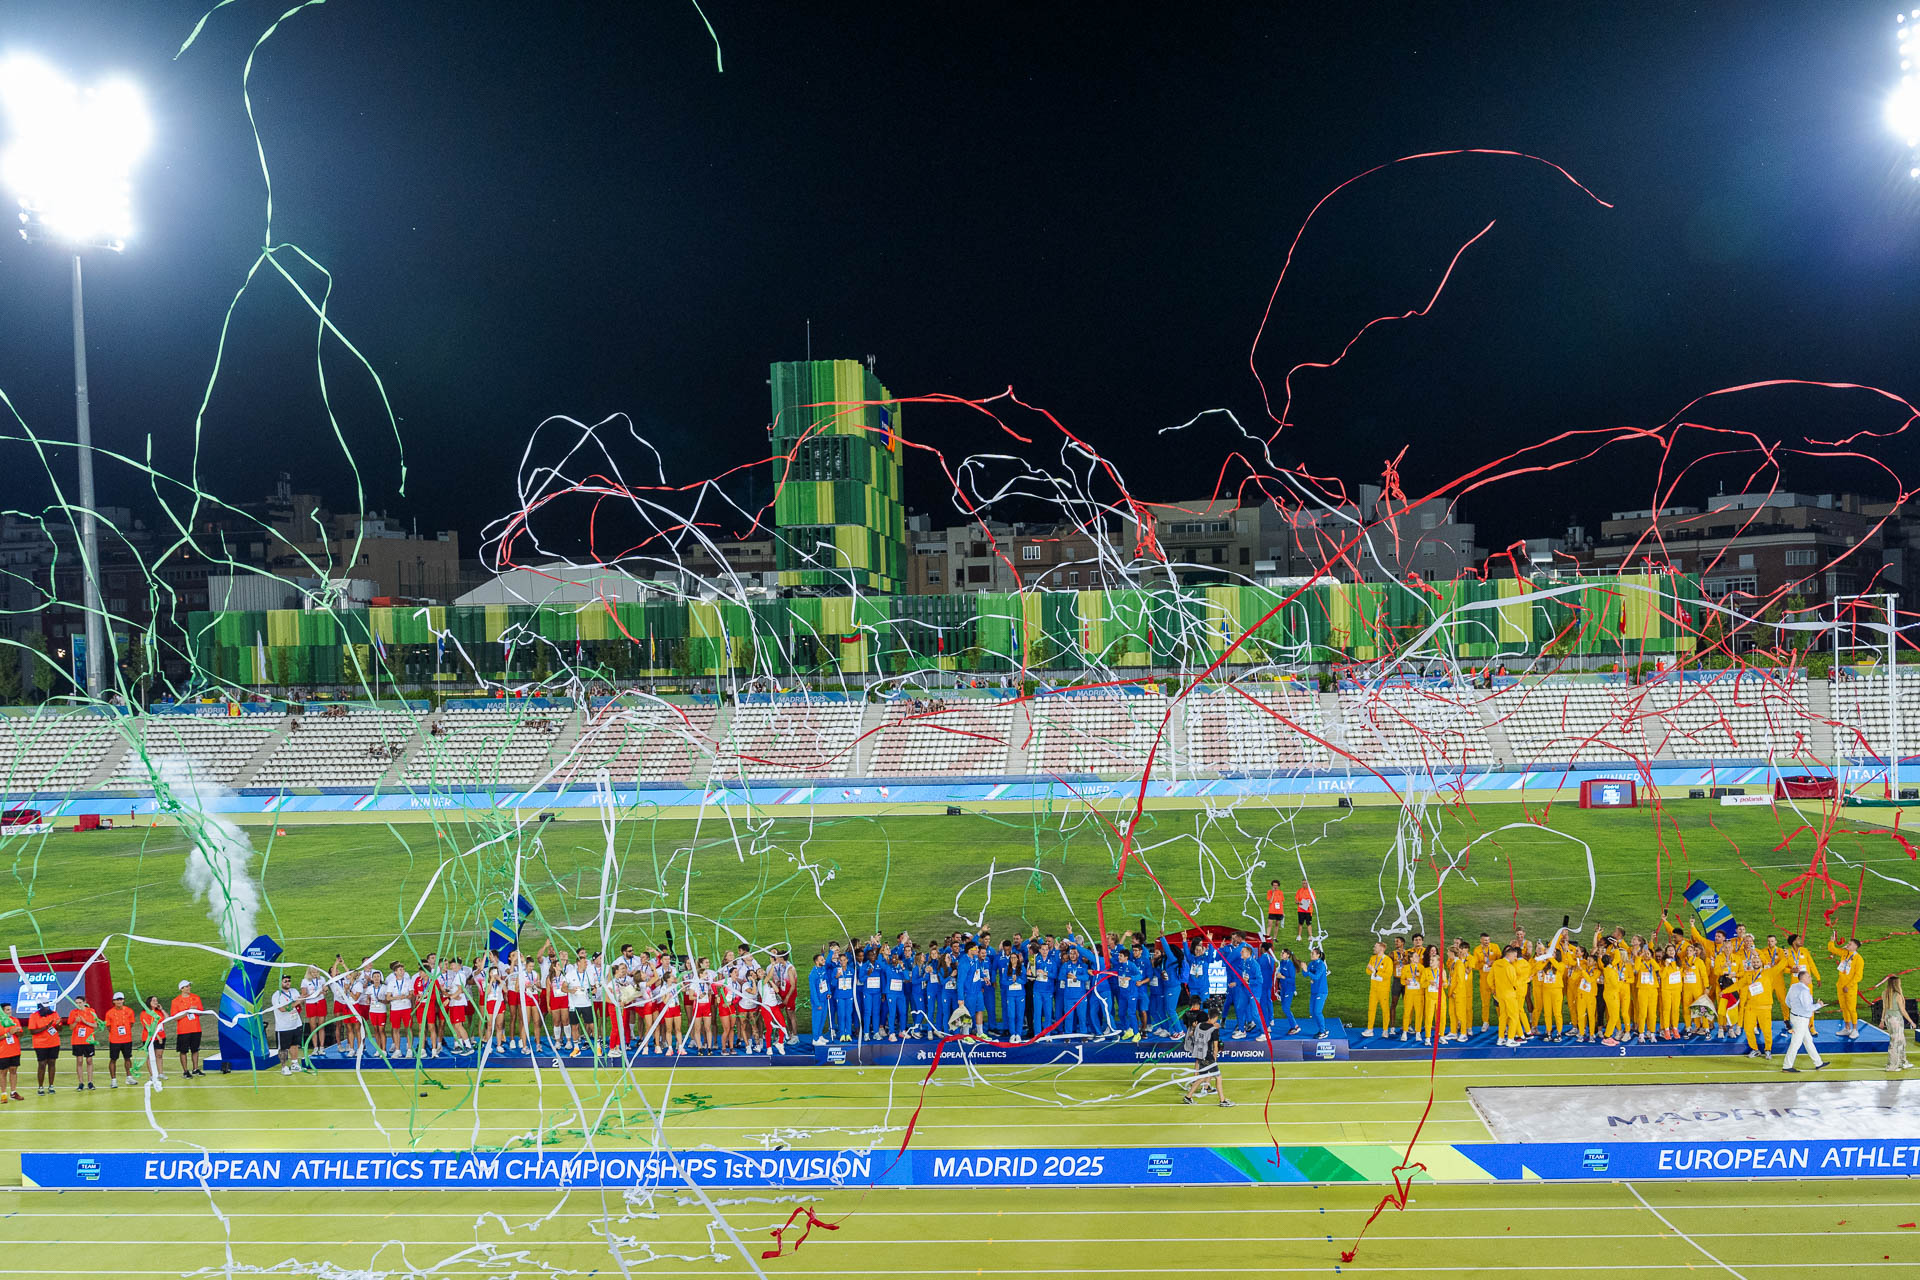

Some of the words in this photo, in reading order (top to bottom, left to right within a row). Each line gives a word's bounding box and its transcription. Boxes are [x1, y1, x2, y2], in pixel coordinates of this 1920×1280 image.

[1596, 773, 1641, 782] WINNER
[1848, 769, 1888, 780] ITALY
[1318, 780, 1355, 790] ITALY
[1208, 968, 1225, 976] EAM
[928, 1051, 967, 1059] EUOPEAN
[1135, 1051, 1157, 1059] TEAM
[1231, 1050, 1265, 1058] DIVISION
[1620, 1046, 1627, 1056] 3
[552, 1058, 559, 1068] 2
[1607, 1108, 1821, 1127] MADRID
[1658, 1148, 1809, 1170] EUROPEAN
[144, 1160, 280, 1180] EUROPEAN
[291, 1160, 425, 1180] ATHLETICS
[429, 1159, 499, 1180] TEAM
[505, 1158, 717, 1180] CHAMPIONSHIPS
[724, 1158, 754, 1179] 1st
[760, 1157, 872, 1179] DIVISION
[933, 1157, 1038, 1177] MADRID
[1043, 1156, 1105, 1177] 2025
